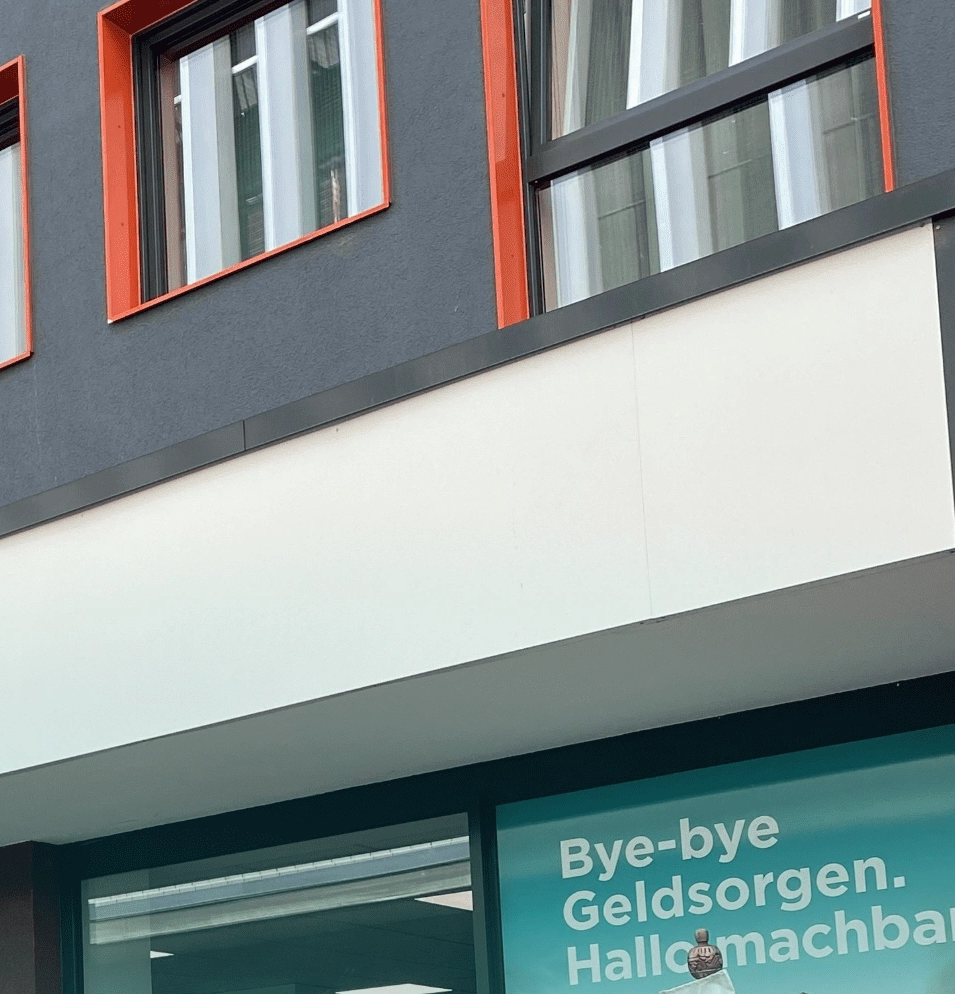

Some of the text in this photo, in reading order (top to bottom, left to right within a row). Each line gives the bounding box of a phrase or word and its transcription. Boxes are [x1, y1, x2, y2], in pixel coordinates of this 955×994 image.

[559, 814, 780, 882] Bye-bye
[562, 856, 907, 931] Geldsorgen.
[566, 933, 691, 986] Hallo
